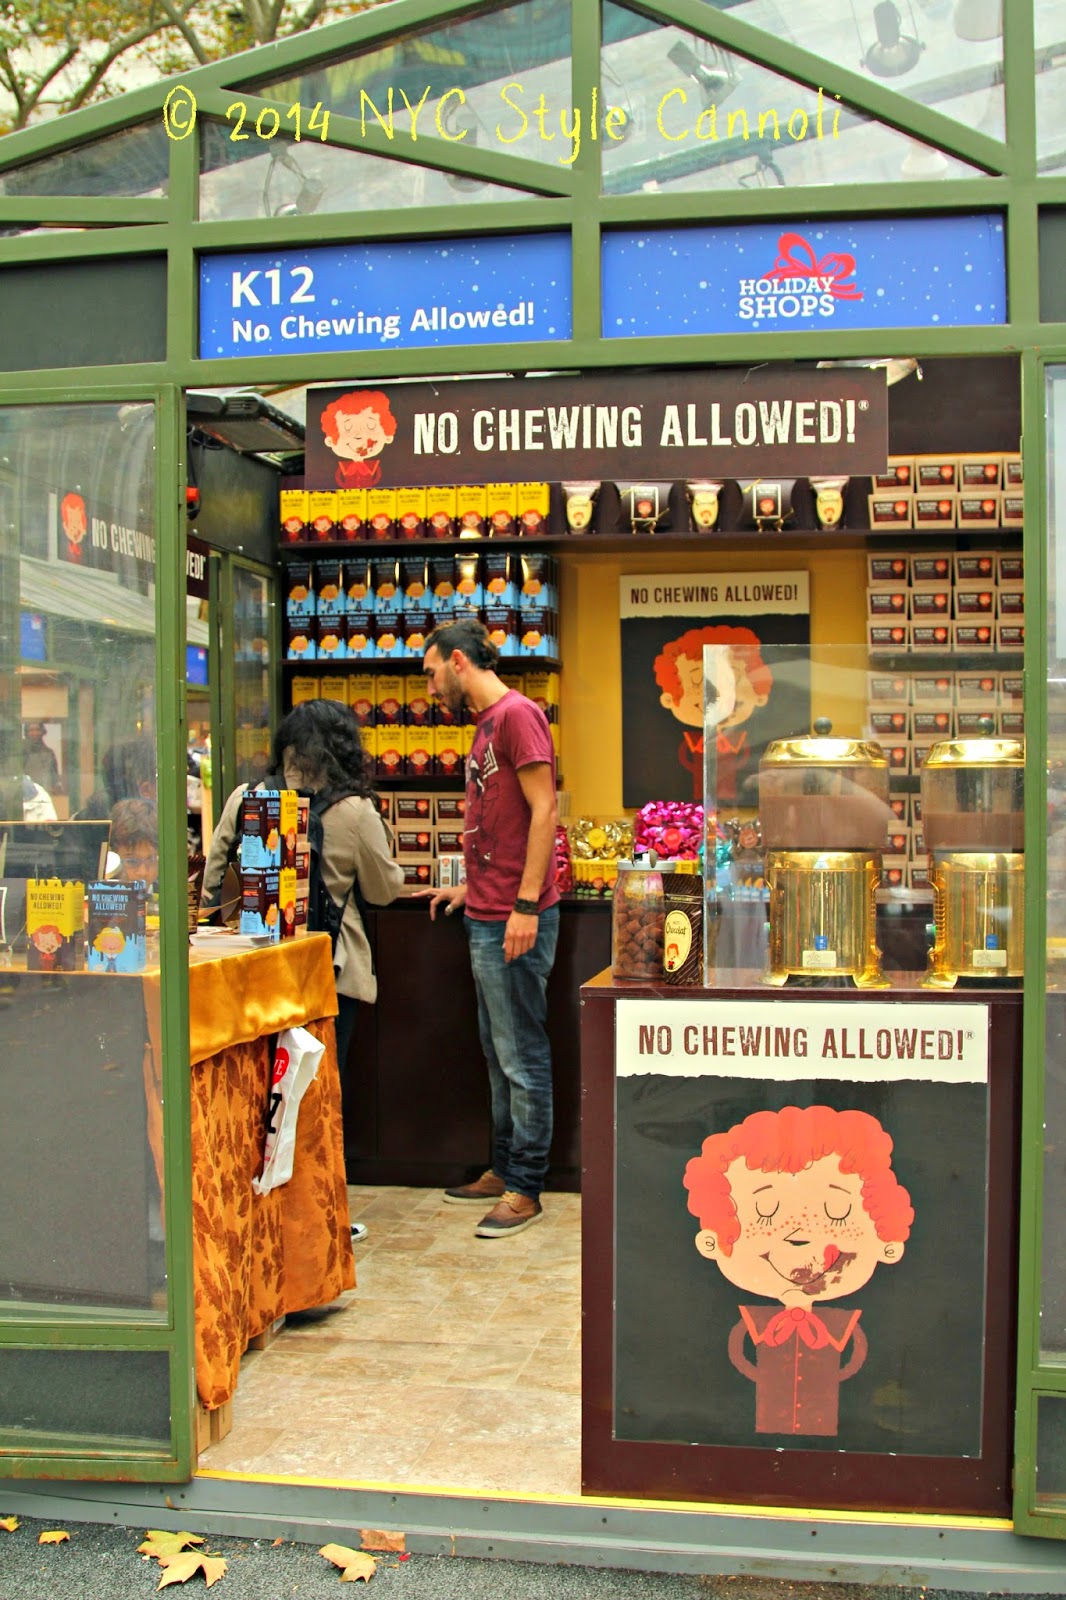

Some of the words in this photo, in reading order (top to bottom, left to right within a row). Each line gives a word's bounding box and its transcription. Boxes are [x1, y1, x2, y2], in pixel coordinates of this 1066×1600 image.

[231, 266, 316, 308] K12
[739, 276, 835, 296] HOLIDAY
[231, 319, 271, 343] No
[280, 311, 401, 339] Chewing
[409, 302, 535, 332] Allowed!
[738, 294, 835, 319] SHOPS
[413, 411, 460, 455] NO
[473, 405, 644, 451] CHEWING
[91, 517, 108, 550] NO
[631, 587, 649, 604] NO
[654, 585, 719, 604] CHEWING
[725, 584, 799, 602] ALLOWED!
[638, 1025, 673, 1056] NO
[683, 1025, 809, 1058] CHEWING
